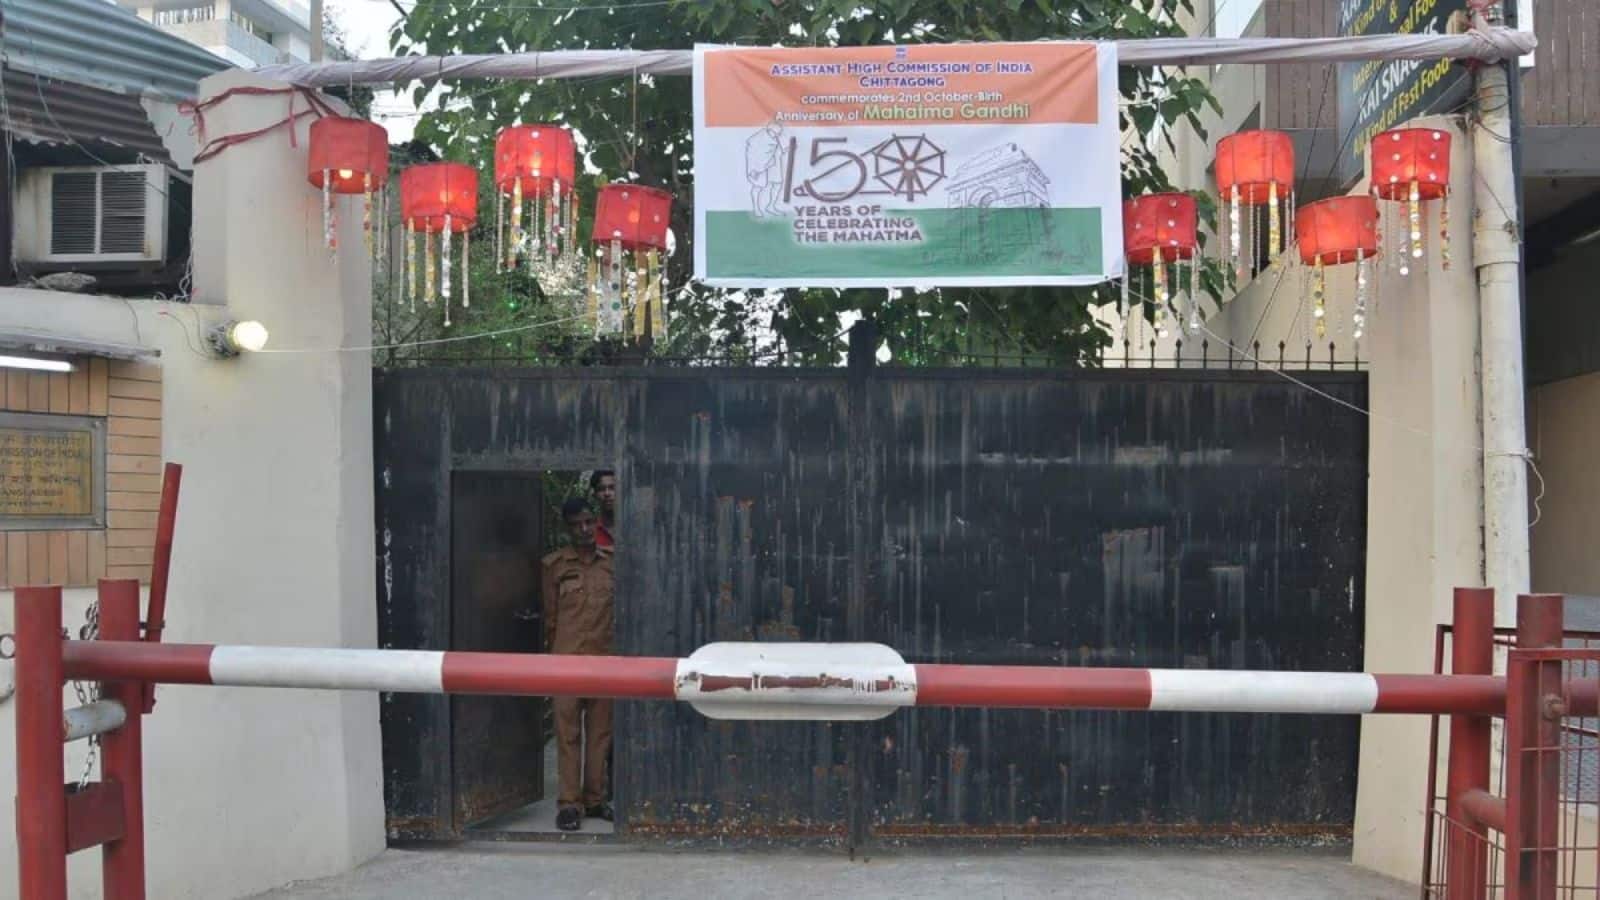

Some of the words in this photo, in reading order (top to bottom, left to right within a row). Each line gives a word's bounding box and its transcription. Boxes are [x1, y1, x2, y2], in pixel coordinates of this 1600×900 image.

[771, 64, 842, 75] ASSISTANT
[847, 62, 881, 73] HIGH
[886, 62, 970, 73] COMMISSION
[996, 61, 1033, 73] INDIA
[859, 76, 945, 87] CHITTAGONG
[801, 93, 895, 104] commemorates
[899, 91, 921, 103] 2nd
[775, 110, 845, 122] Anniversary
[847, 110, 859, 120] of
[863, 103, 954, 120] Mahatma
[960, 103, 1029, 119] Gandhi
[794, 205, 851, 217] YEARS
[857, 204, 881, 216] OF
[793, 217, 915, 230] CELEBRATING
[793, 231, 829, 242] THE
[833, 230, 922, 242] MAHATMA
